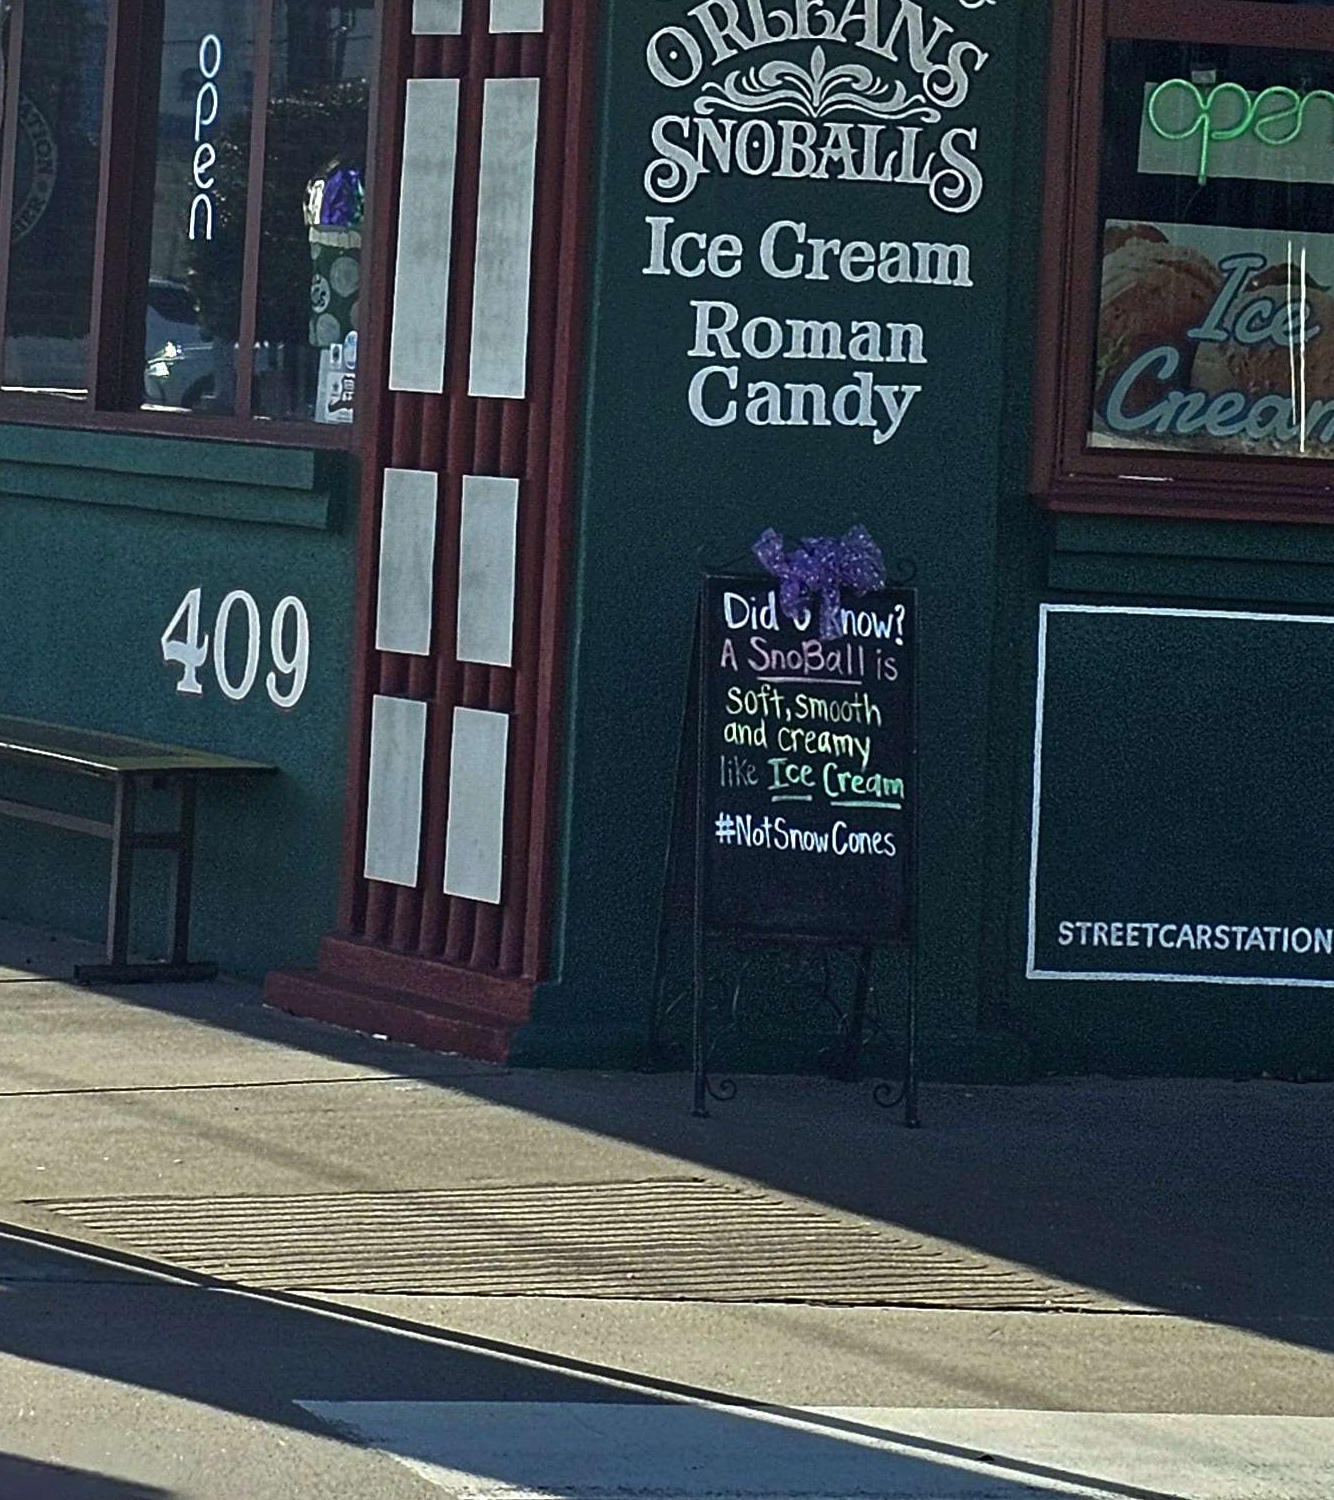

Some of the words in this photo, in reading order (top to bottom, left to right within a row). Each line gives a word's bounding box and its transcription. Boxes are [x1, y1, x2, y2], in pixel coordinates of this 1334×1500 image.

[189, 34, 221, 240] open
[644, 114, 982, 212] SNOBALLS
[643, 216, 743, 277] Ice
[760, 220, 973, 287] Cream
[687, 300, 927, 363] Roman
[1187, 253, 1321, 346] Ice
[688, 366, 921, 444] Candy
[724, 591, 779, 631] Did
[161, 587, 309, 708] 409
[721, 638, 738, 671] A
[748, 637, 864, 678] SnoBall
[876, 649, 899, 681] is
[720, 755, 759, 787] like
[768, 757, 816, 790] Ice
[823, 763, 905, 799] Cream
[724, 721, 767, 749] and
[778, 727, 871, 770] creamy
[1058, 921, 1334, 954] STREETCARSTATION
